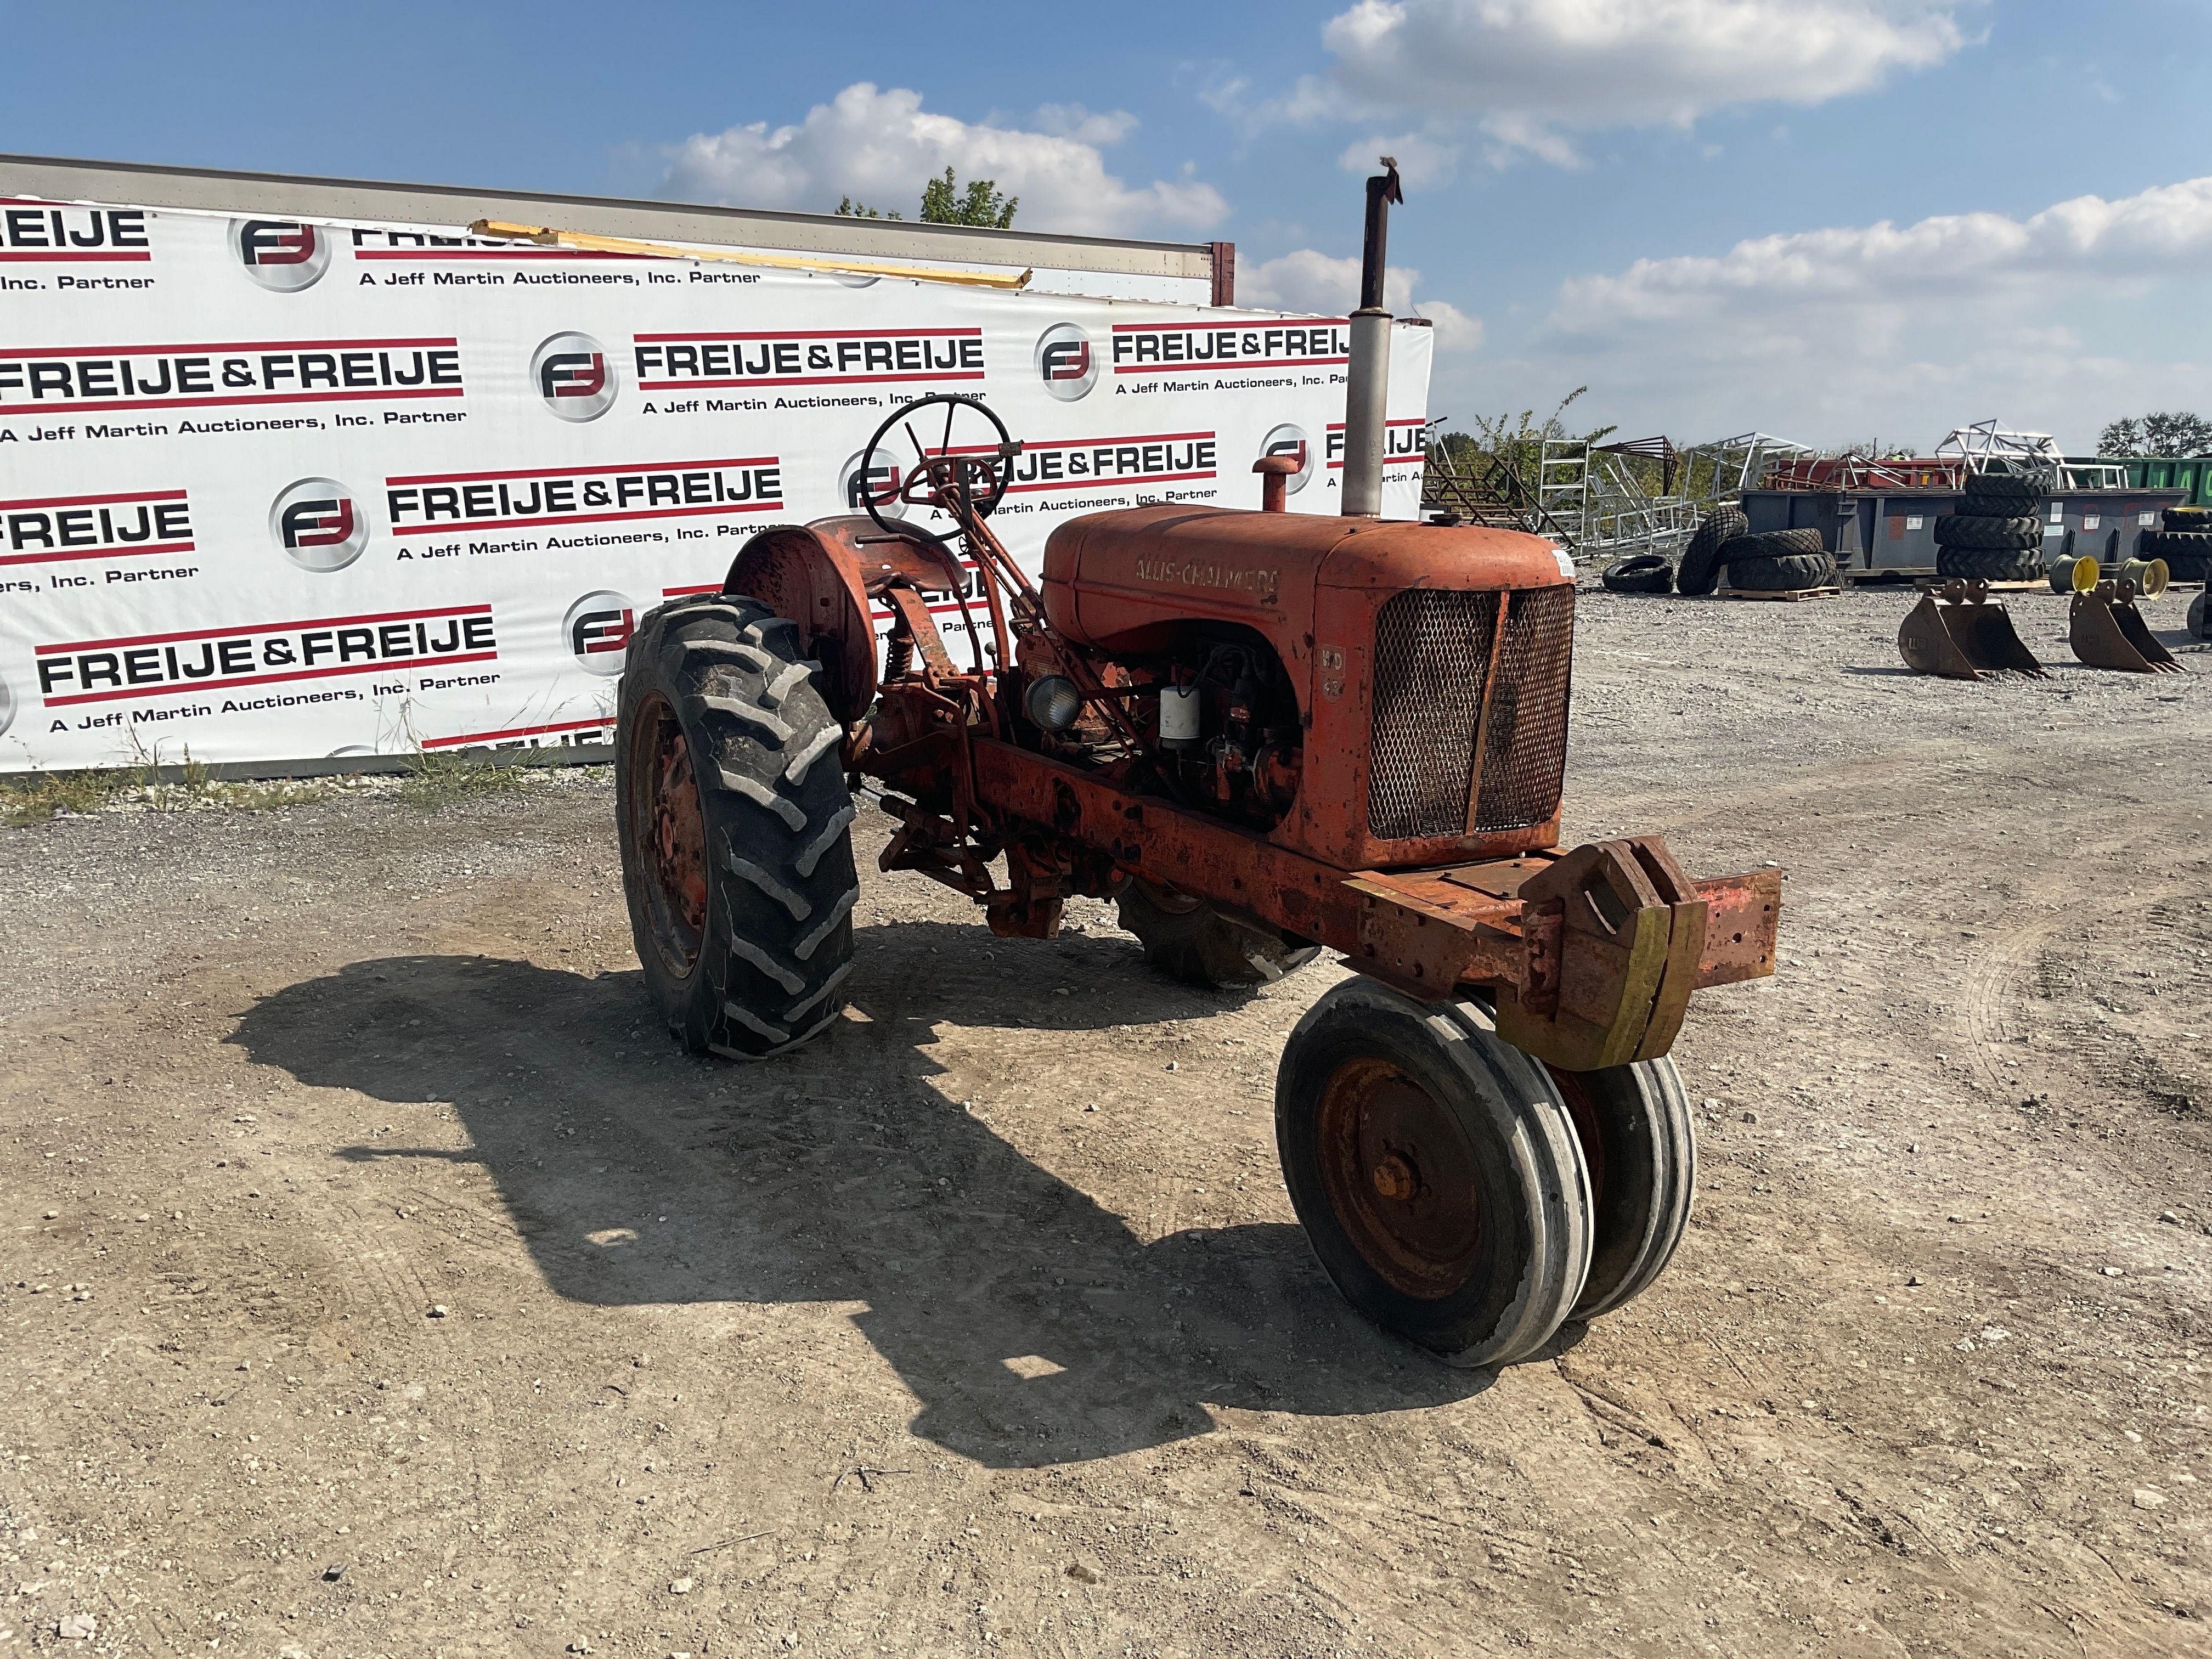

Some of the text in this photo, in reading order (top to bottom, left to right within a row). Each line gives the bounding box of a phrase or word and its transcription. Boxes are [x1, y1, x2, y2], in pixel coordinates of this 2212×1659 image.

[1, 276, 155, 290] Inc. Partner
[359, 271, 761, 286] A Jeff Martin Auctioneers, Inc. Partner
[1115, 384, 1127, 394] A
[1131, 382, 1158, 393] Jeff
[1163, 381, 1209, 392] Martin
[1214, 379, 1296, 390] Auctioneers,
[1302, 375, 1324, 385] Inc.
[642, 402, 658, 414] A
[664, 400, 699, 413] Jeff
[706, 398, 767, 411] Martin
[774, 396, 883, 409] Auctioneers,
[0, 412, 467, 443] A Jeff Martin Auctioneers, Inc. Partner
[1327, 478, 1336, 487] A
[930, 509, 943, 520] A
[1039, 498, 1130, 512] Auctioneers,
[1166, 490, 1217, 501] Partner
[397, 548, 414, 561] A
[421, 544, 461, 558] Jeff
[469, 539, 538, 555] Martin
[546, 533, 669, 549] Auctioneers,
[677, 528, 709, 539] Inc.
[50, 575, 95, 588] Inc.
[105, 567, 199, 584] Partner
[49, 674, 500, 733] A Jeff Martin Auctioneers, Inc. Partner
